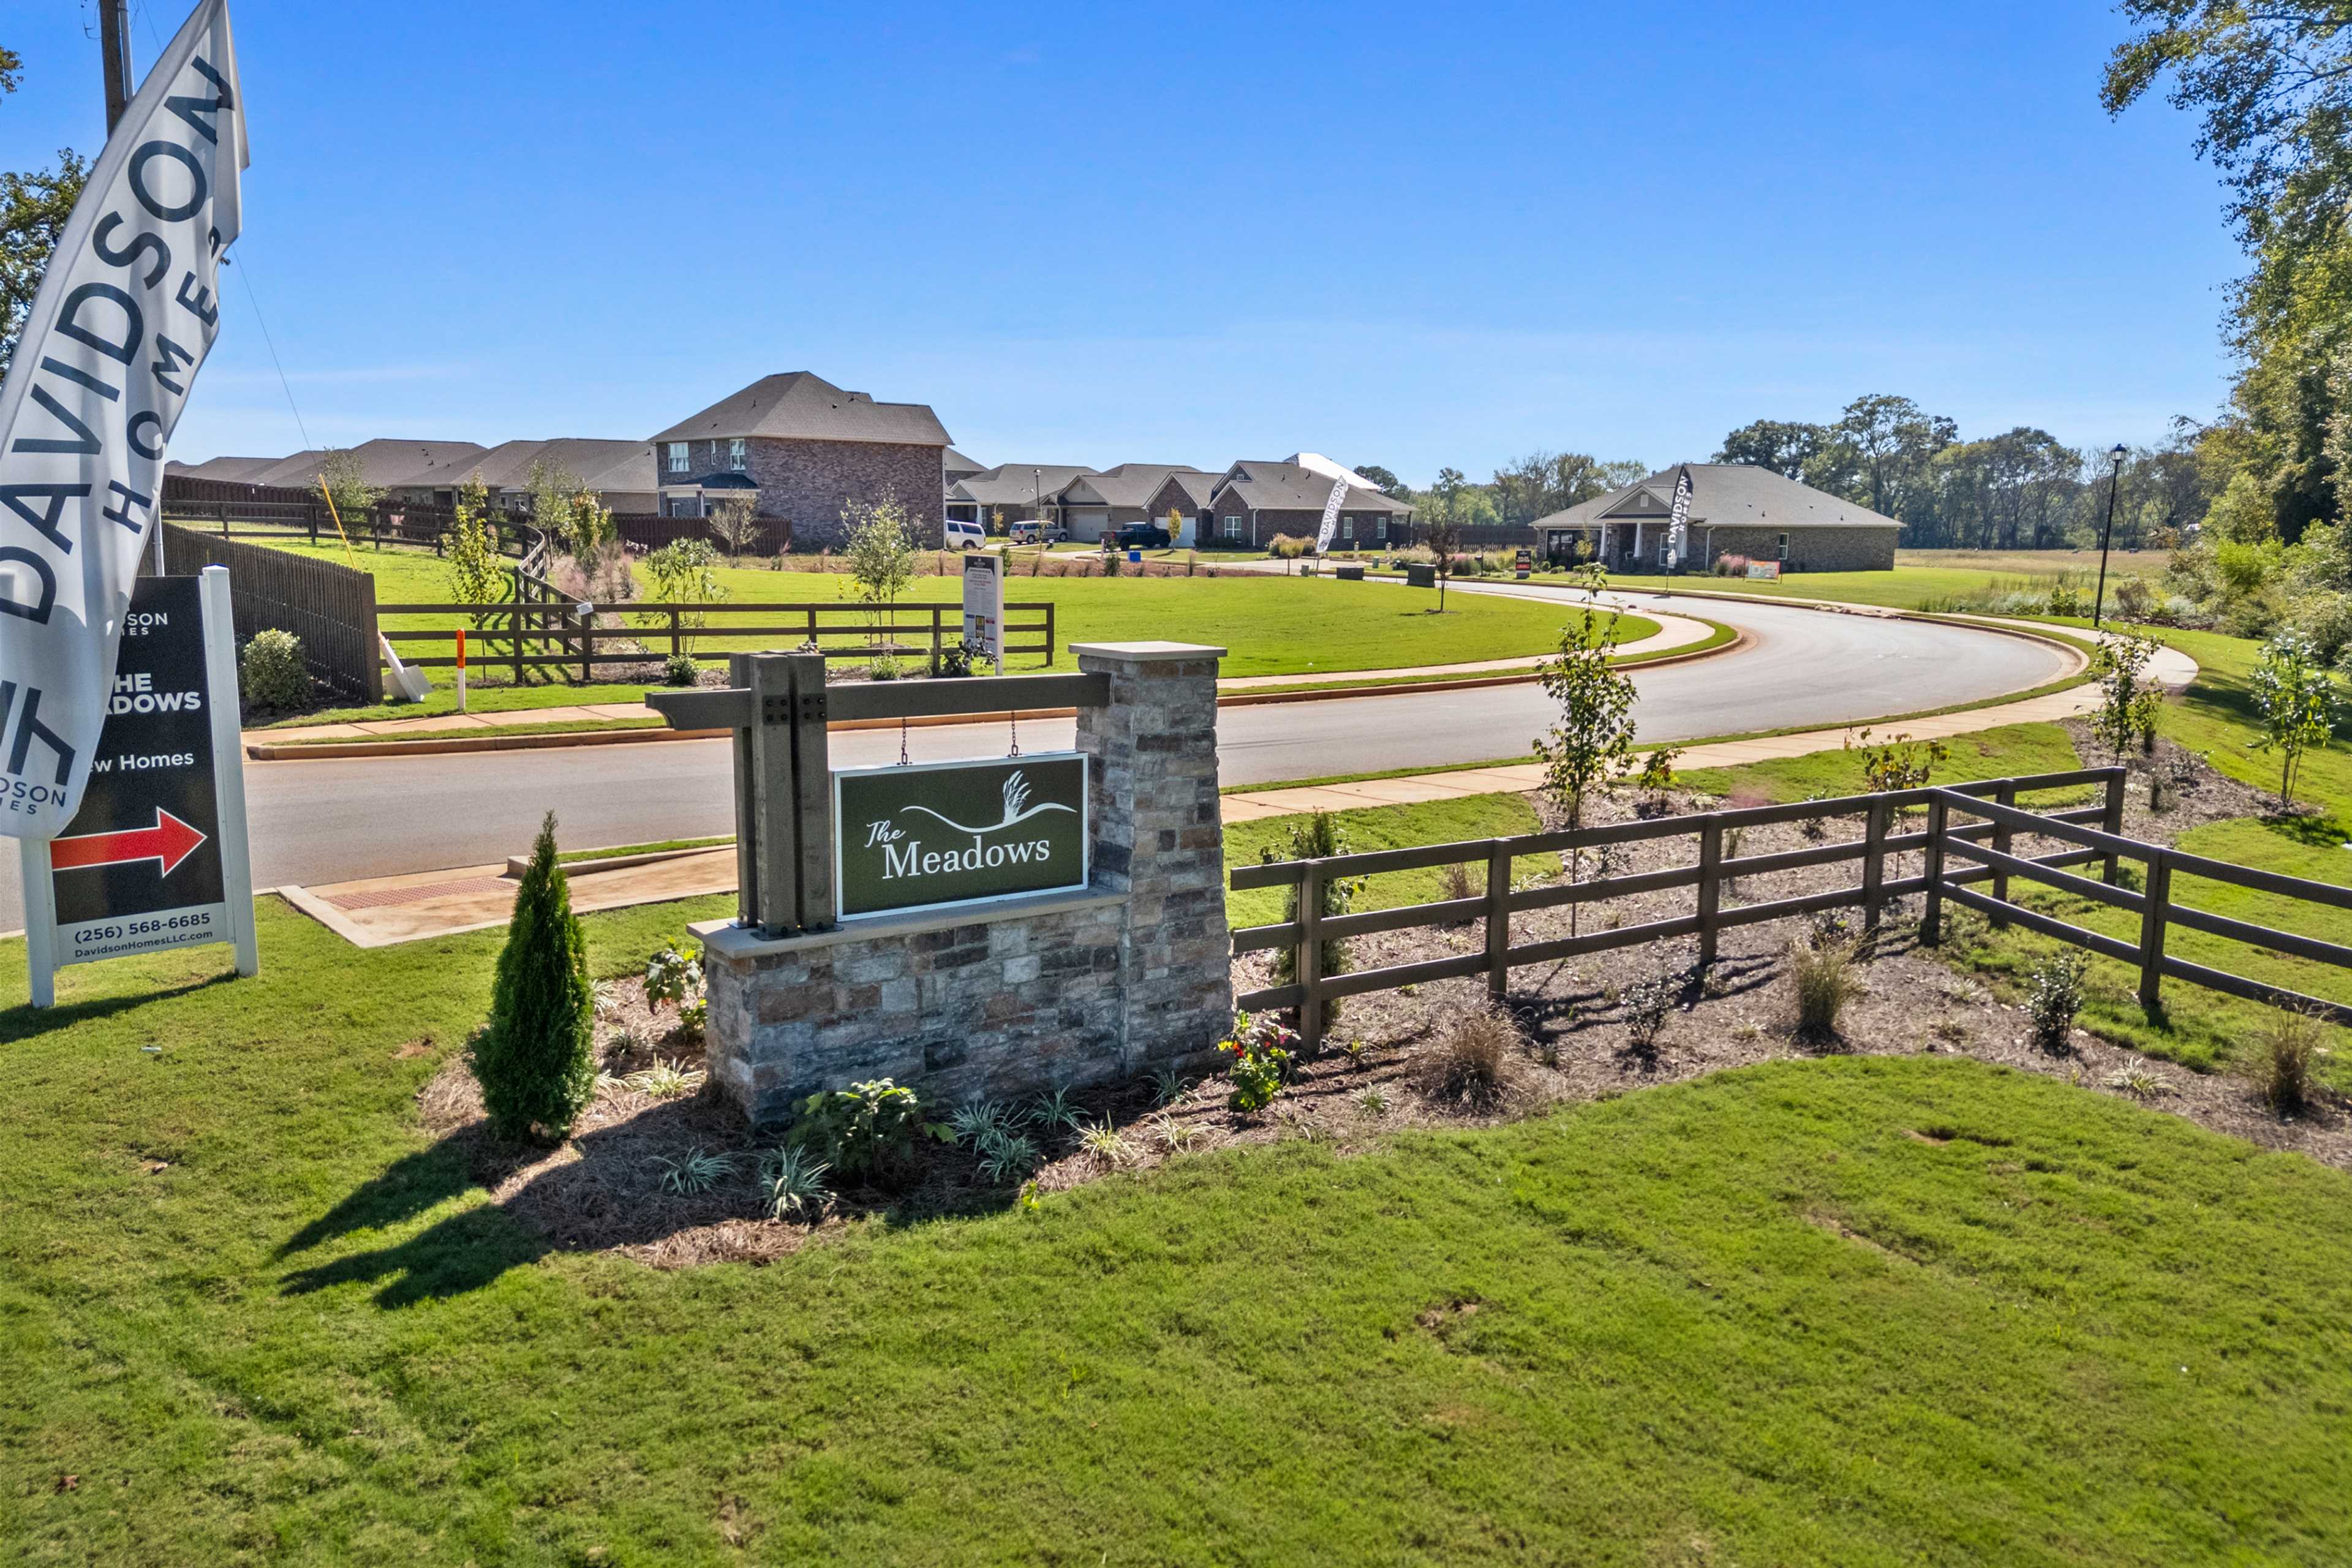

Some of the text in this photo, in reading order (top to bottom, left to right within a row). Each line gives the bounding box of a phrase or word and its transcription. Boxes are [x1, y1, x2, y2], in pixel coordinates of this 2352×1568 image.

[0, 55, 235, 625] DAVIDSON
[1321, 481, 1344, 535] DAVIDSON
[1668, 475, 1689, 543] DAVIDSON
[1679, 491, 1693, 532] HOMES
[114, 673, 153, 693] HE
[107, 692, 202, 715] DOWS
[120, 753, 194, 770] Homes
[864, 820, 907, 848] The
[881, 835, 1050, 880] Meadows
[75, 913, 211, 944] (256) 568-6685
[75, 930, 213, 958] DavidsonHomesLLC.com
